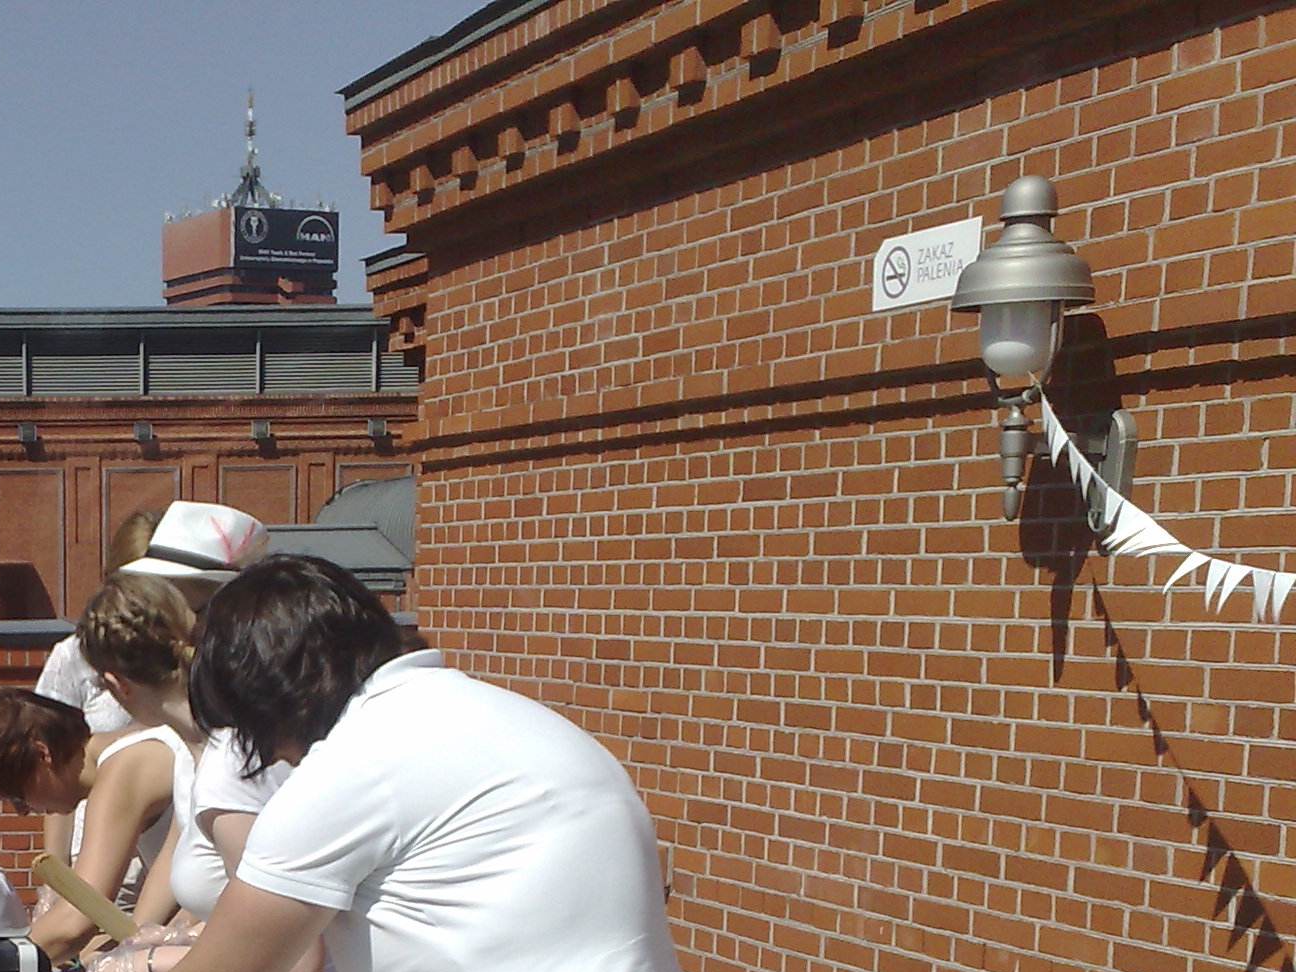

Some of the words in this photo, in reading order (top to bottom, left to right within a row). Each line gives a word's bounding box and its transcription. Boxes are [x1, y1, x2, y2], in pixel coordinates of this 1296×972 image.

[300, 231, 333, 242] MAN
[917, 241, 955, 266] ZAKAZ
[917, 259, 965, 284] PALENIA
